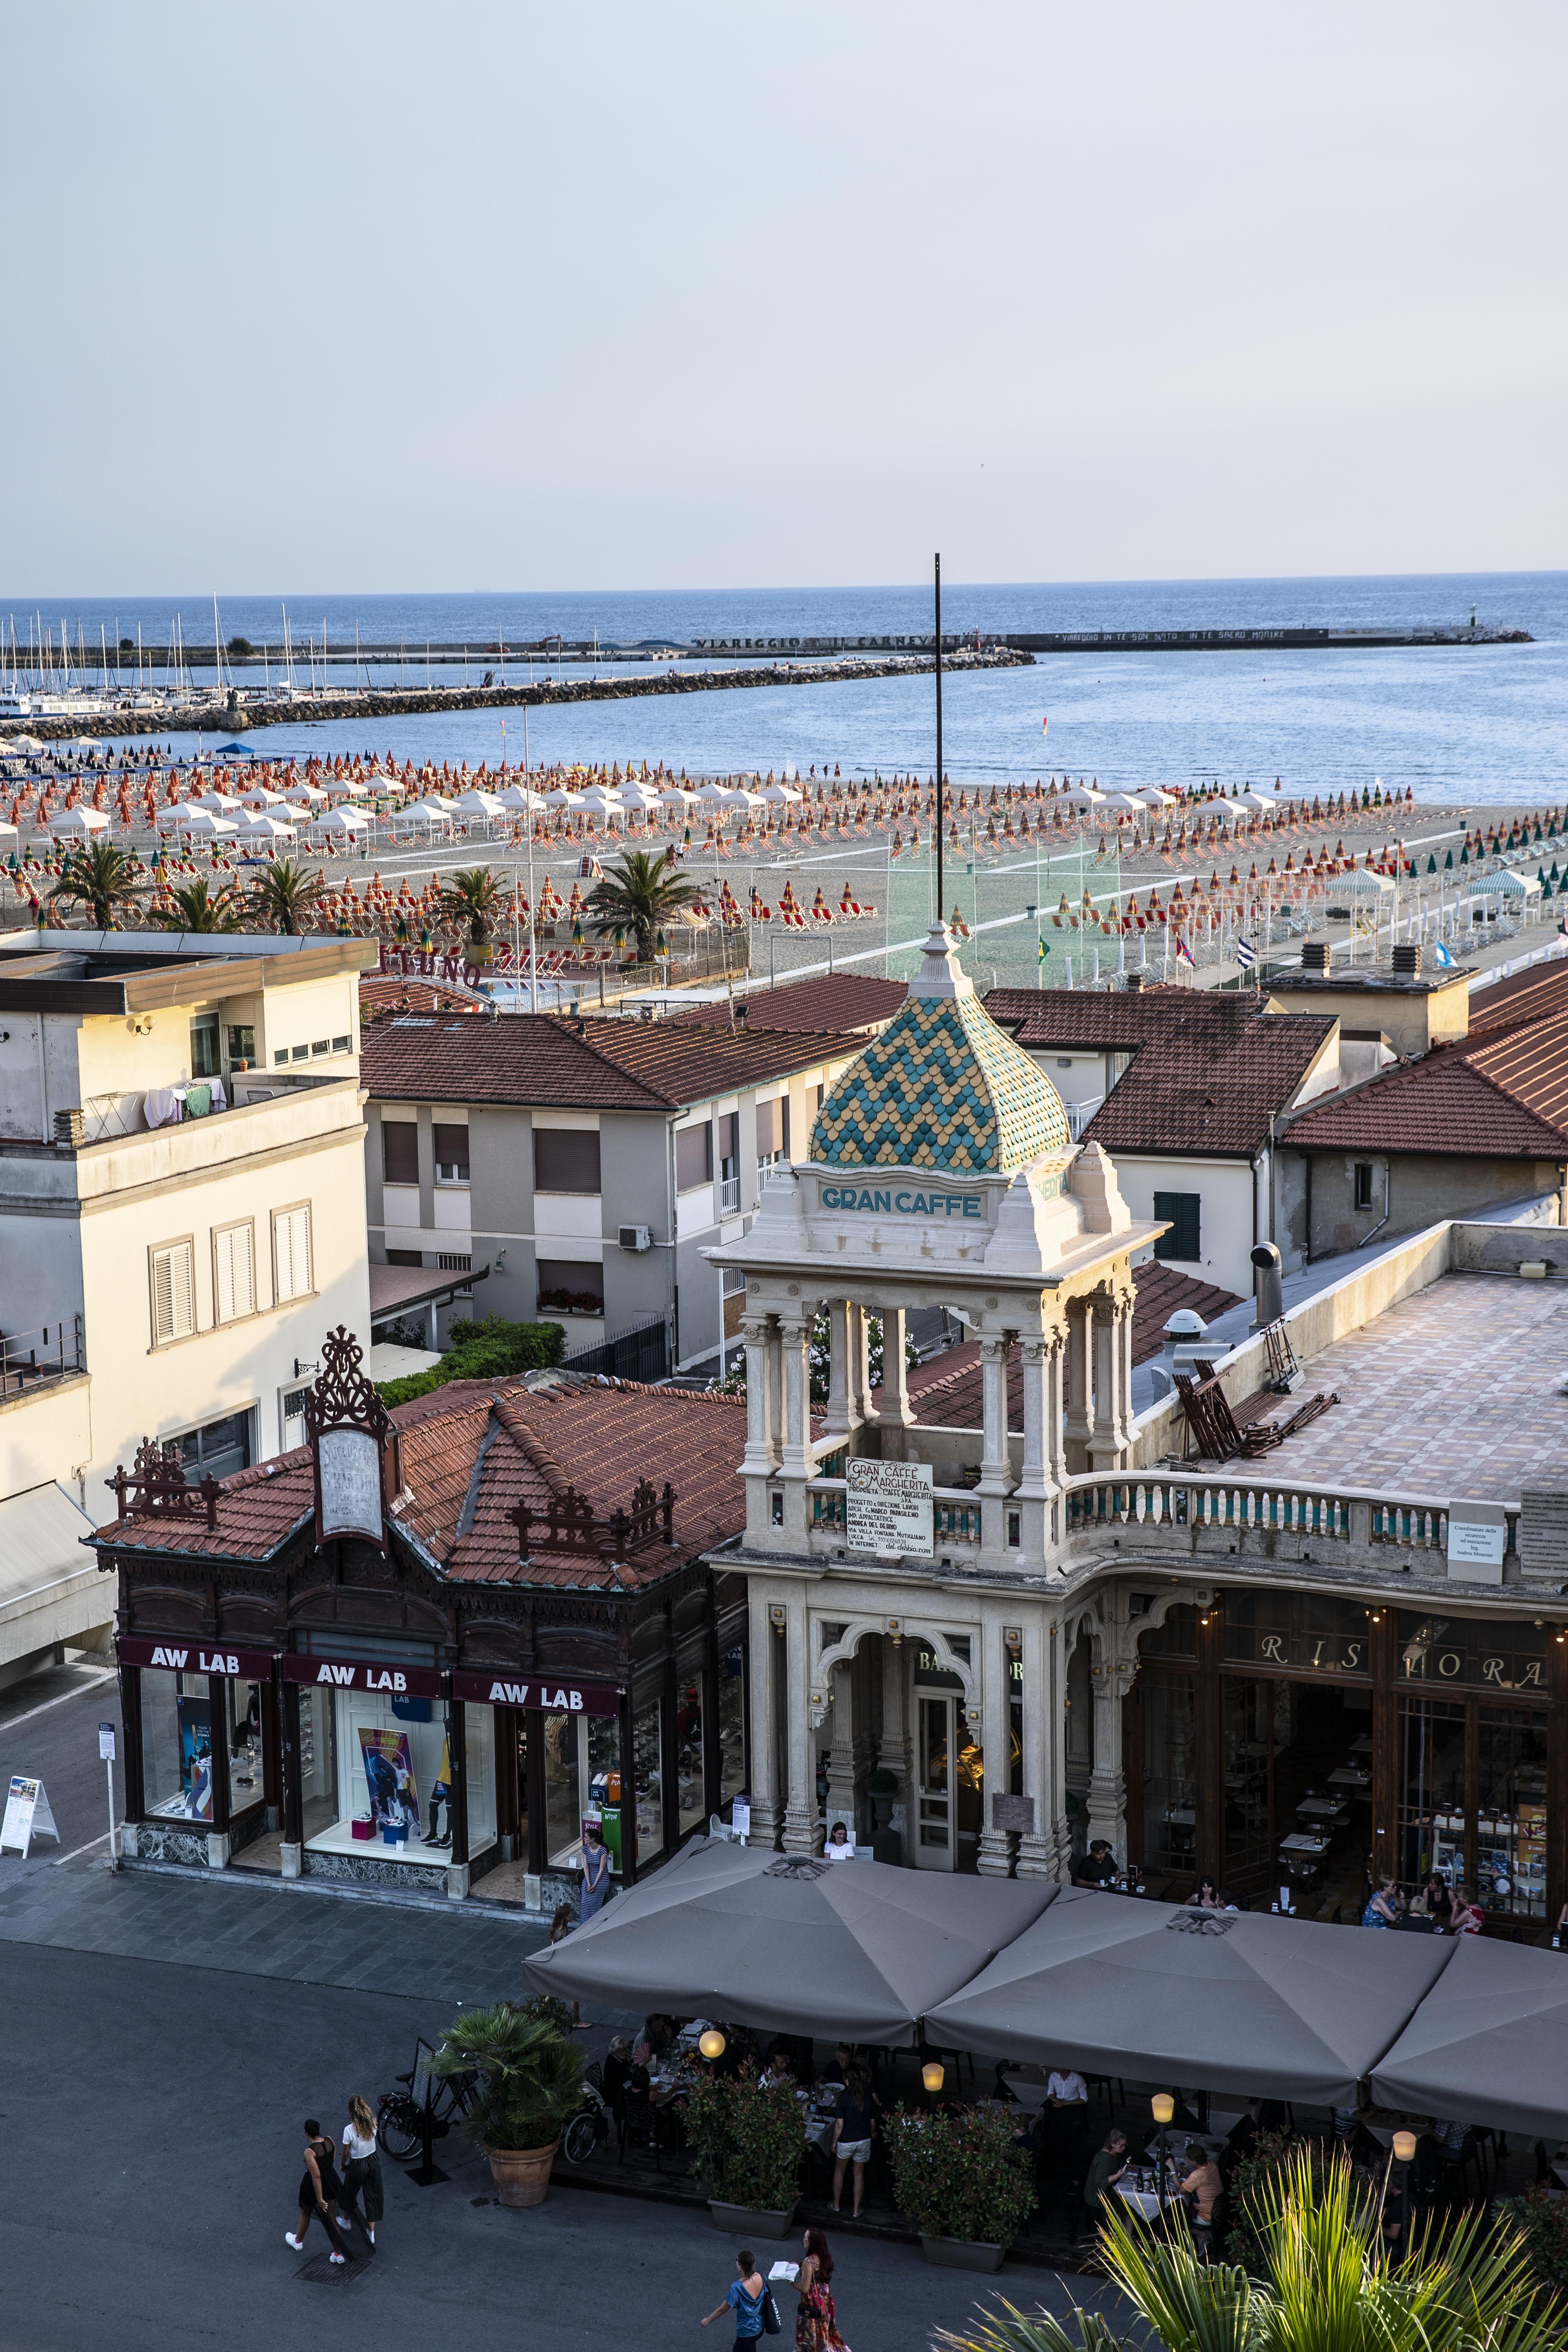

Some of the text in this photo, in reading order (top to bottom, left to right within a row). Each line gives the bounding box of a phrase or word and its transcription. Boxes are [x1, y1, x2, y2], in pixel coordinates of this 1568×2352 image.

[698, 638, 800, 648] VIAREGGIO
[822, 1188, 981, 1217] GRAN CAFFE
[852, 1464, 919, 1479] GRAN CAFFÈ
[867, 1476, 930, 1491] MARGHERITA
[883, 1488, 901, 1496] CAFFÈ
[901, 1490, 933, 1500] MARGHERITA
[890, 1510, 919, 1518] PARASILENO
[897, 1531, 925, 1540] MUTIGLIANO
[150, 1647, 239, 1674] AW LAB
[919, 1652, 954, 1672] BA
[317, 1664, 407, 1692] AW LAB
[489, 1682, 583, 1710] AW LAB
